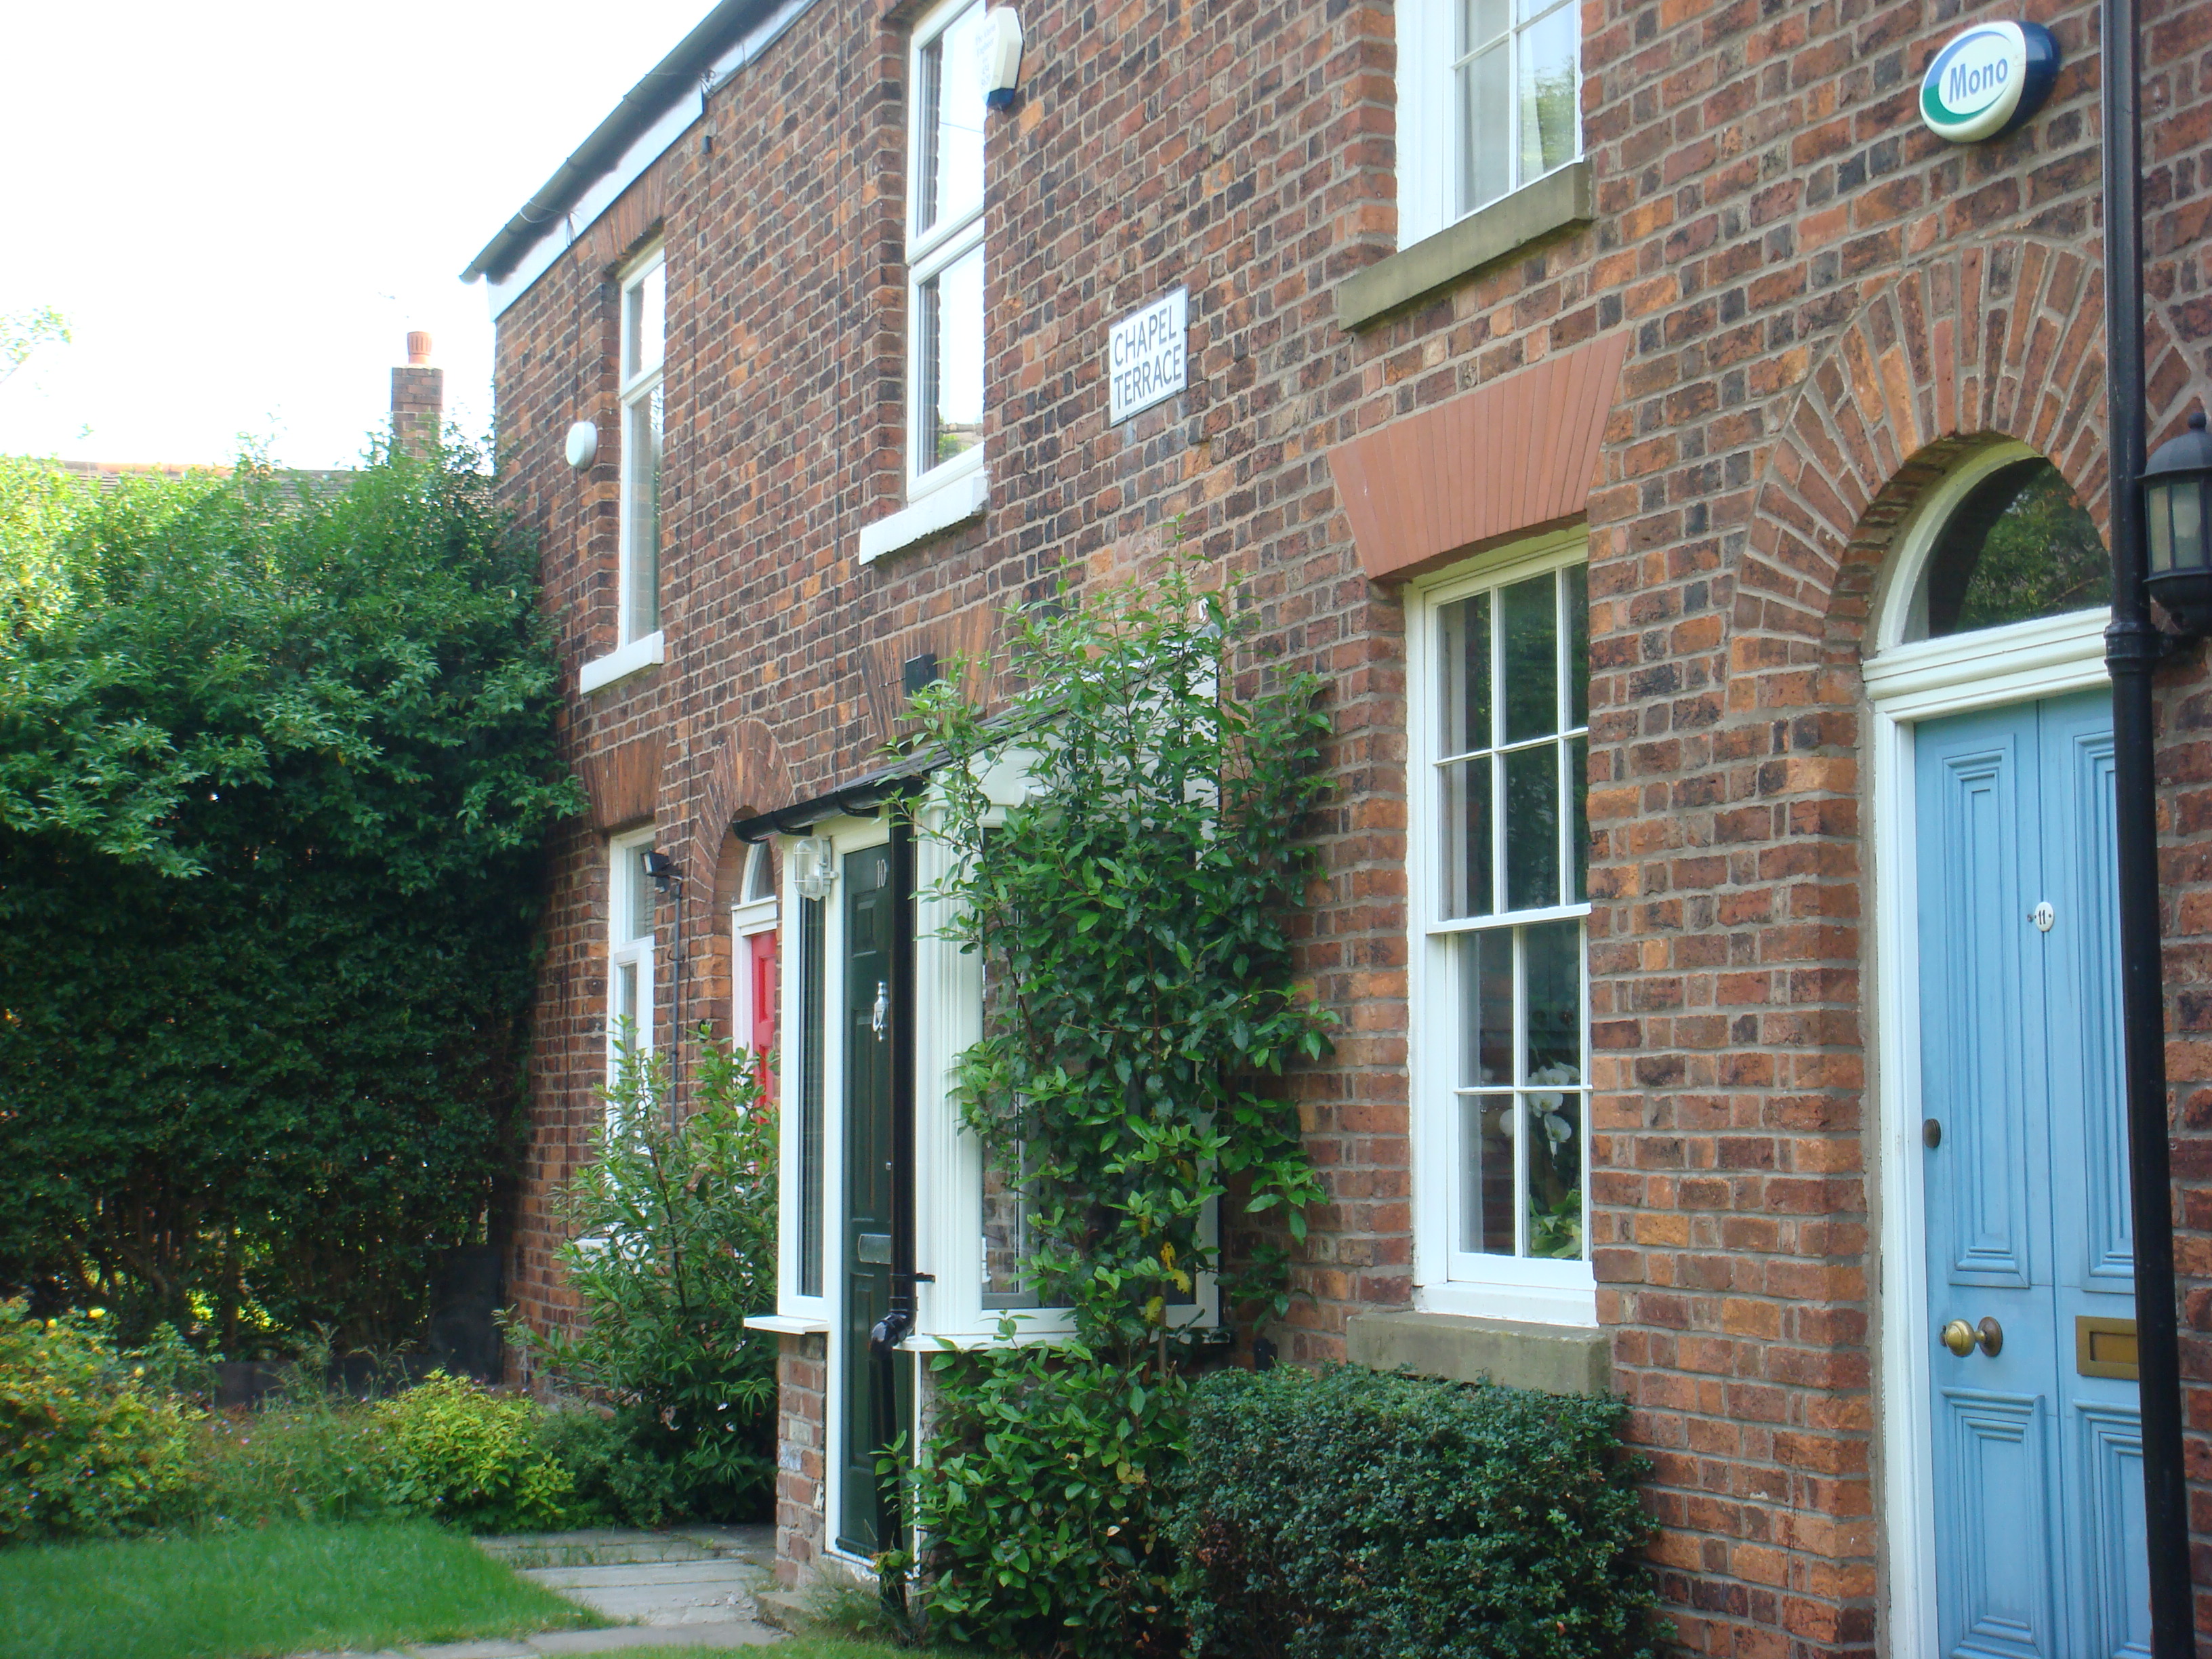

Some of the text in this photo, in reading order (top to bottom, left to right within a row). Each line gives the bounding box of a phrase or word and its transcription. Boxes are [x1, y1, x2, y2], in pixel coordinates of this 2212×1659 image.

[1949, 58, 2008, 104] Mono
[1114, 305, 1177, 367] CHAPEL
[1114, 344, 1182, 410] TERRACE
[876, 859, 887, 888] 10
[2038, 909, 2046, 925] 11
